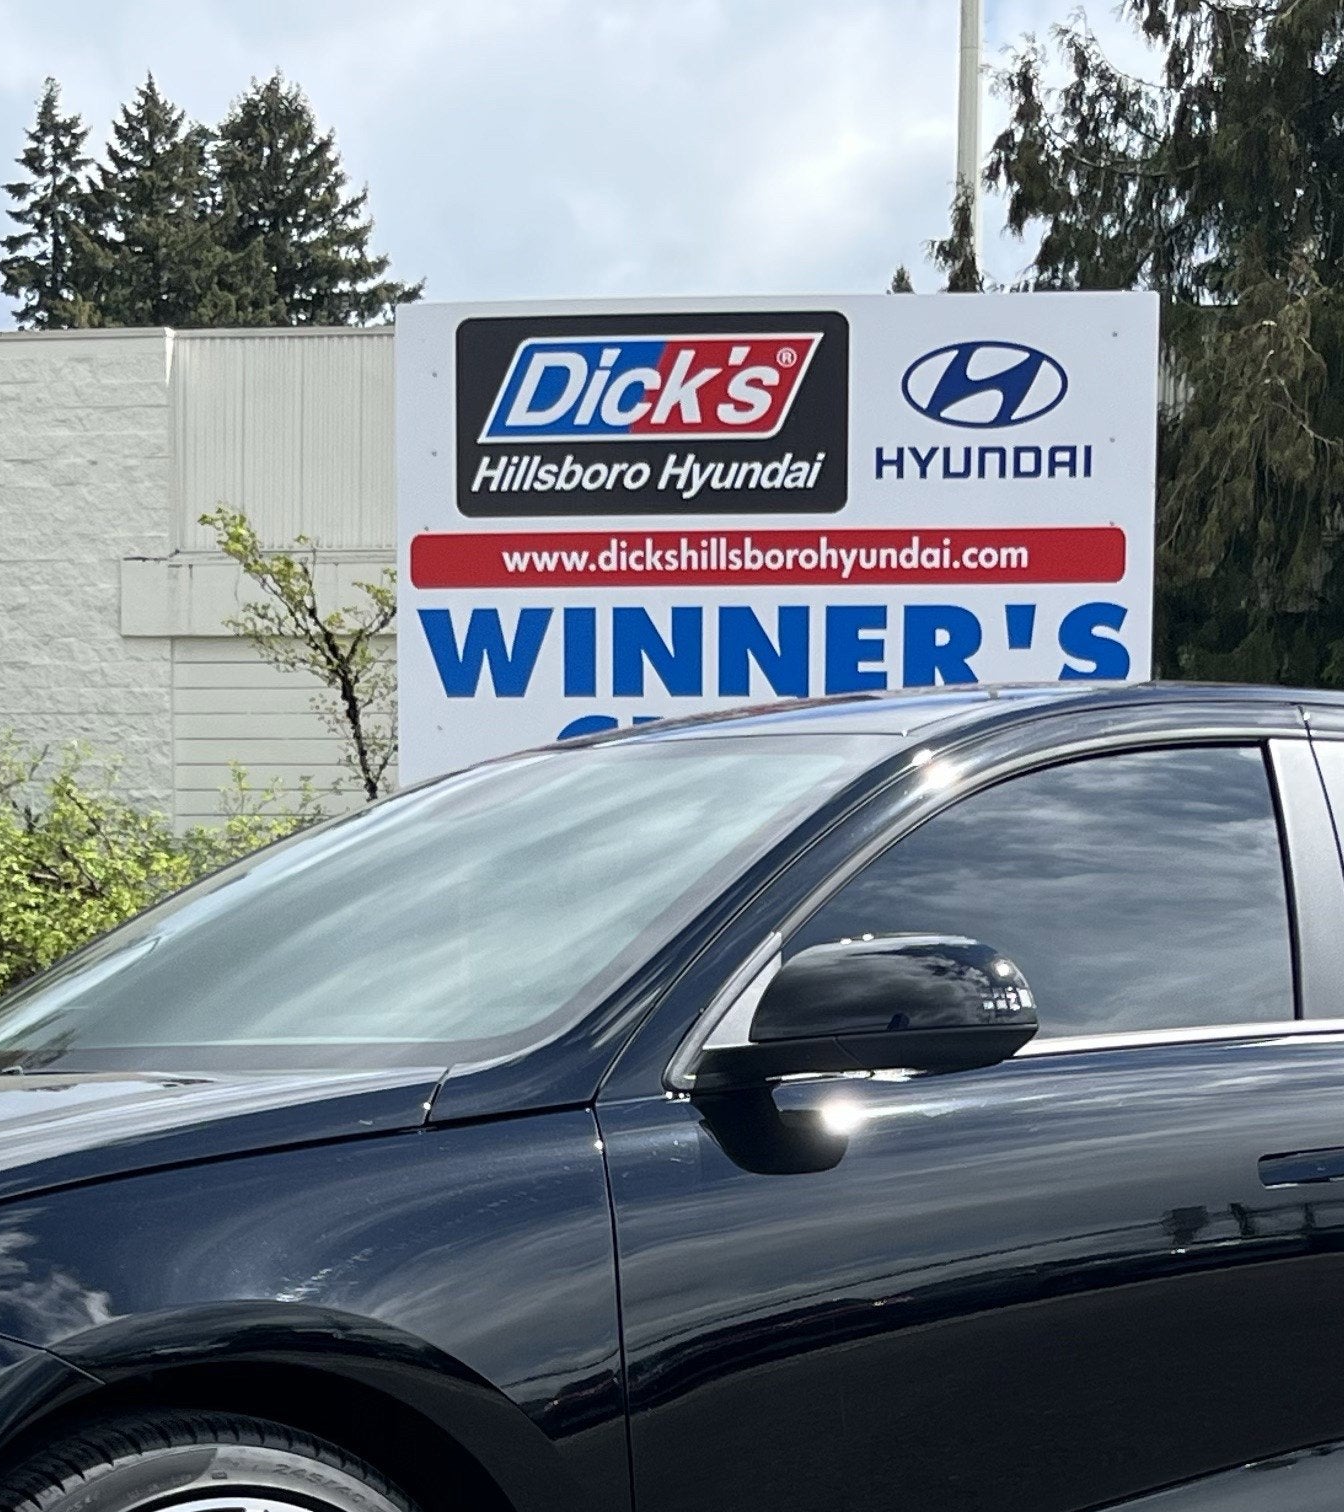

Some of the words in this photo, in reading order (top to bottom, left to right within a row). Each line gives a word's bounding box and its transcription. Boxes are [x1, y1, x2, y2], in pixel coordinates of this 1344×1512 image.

[505, 346, 782, 427] Dick's
[471, 455, 651, 492] Hillsboro
[657, 452, 826, 499] Hyundai
[876, 445, 1092, 480] HYUNDAI
[502, 539, 1029, 578] www.dickshillsborohyundai.com
[417, 600, 1131, 699] WINNER'S
